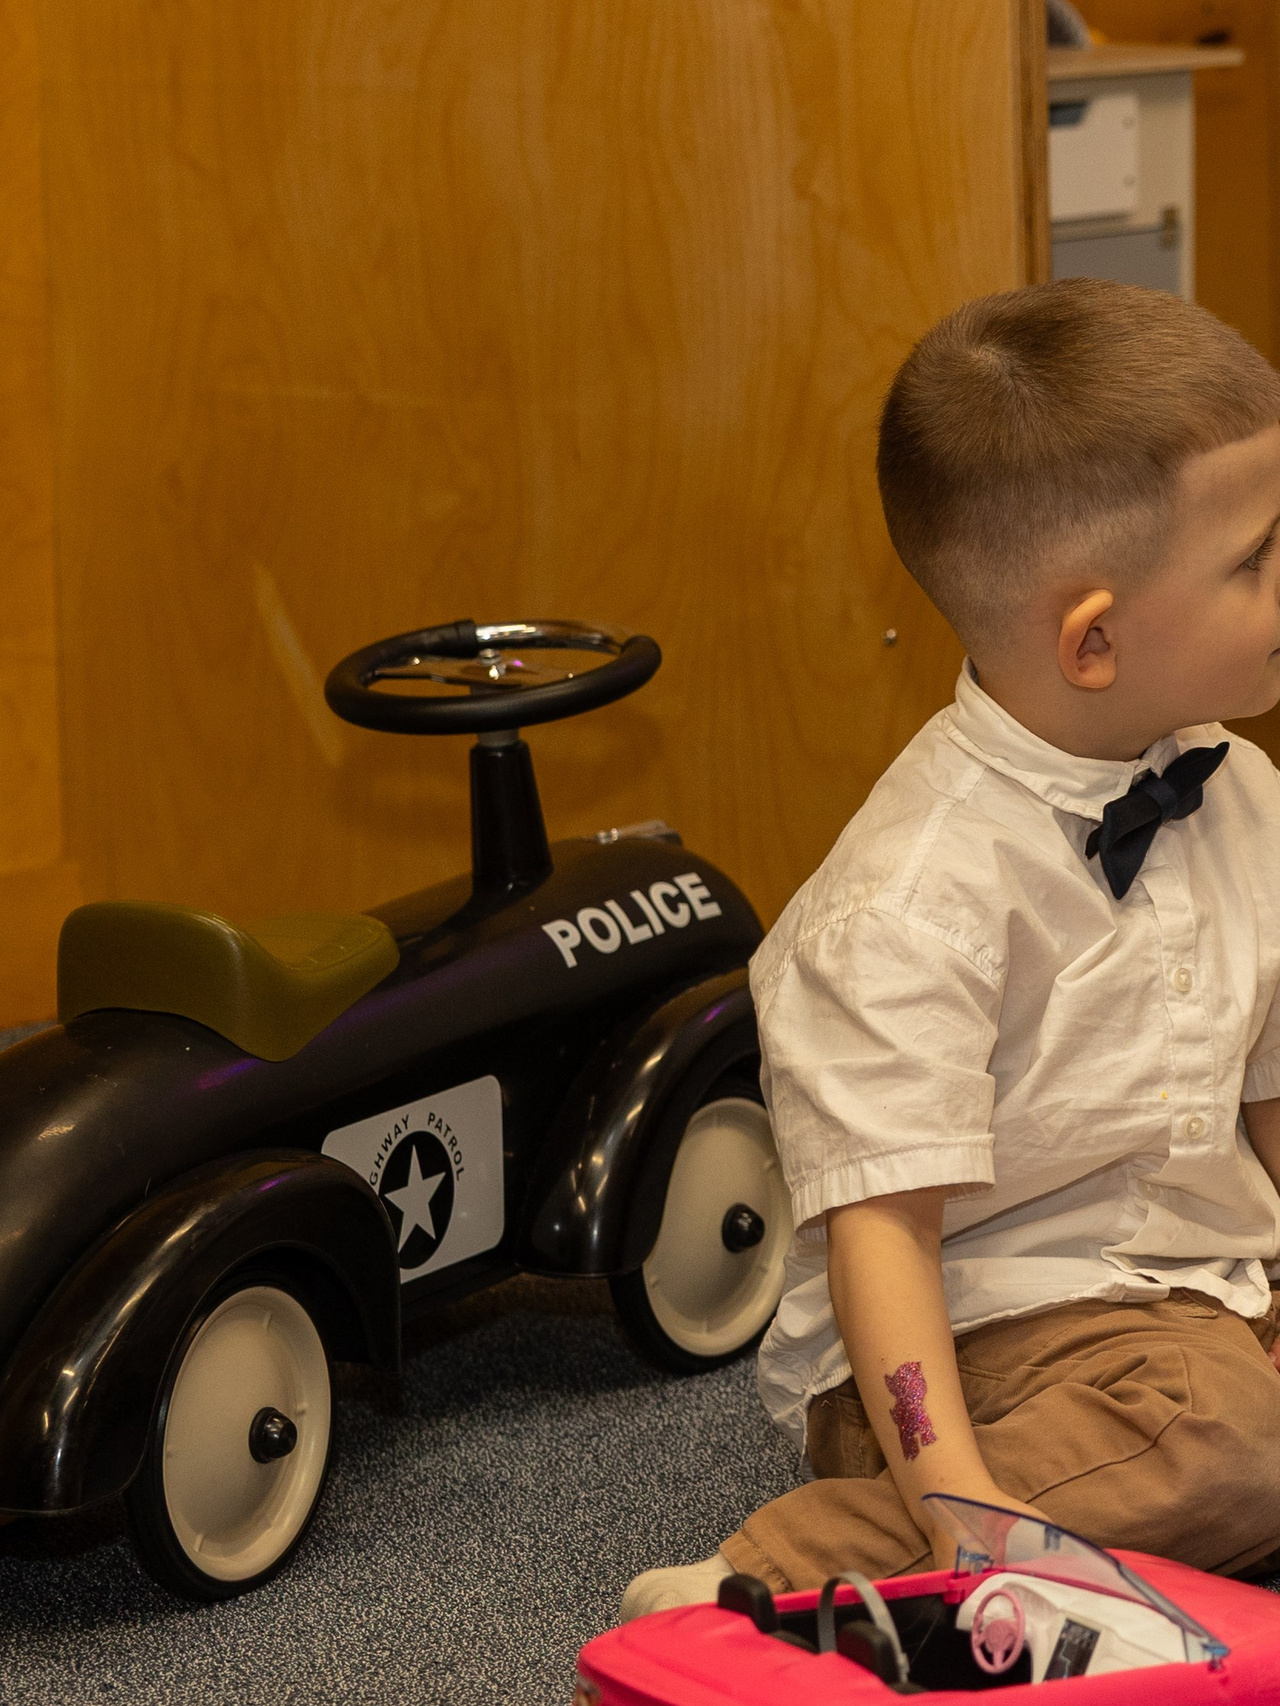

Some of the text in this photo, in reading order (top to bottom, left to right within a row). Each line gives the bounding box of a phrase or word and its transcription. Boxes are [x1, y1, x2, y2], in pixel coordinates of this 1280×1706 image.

[541, 872, 722, 968] POLICE
[369, 1112, 464, 1186] GHWAY PATROL
